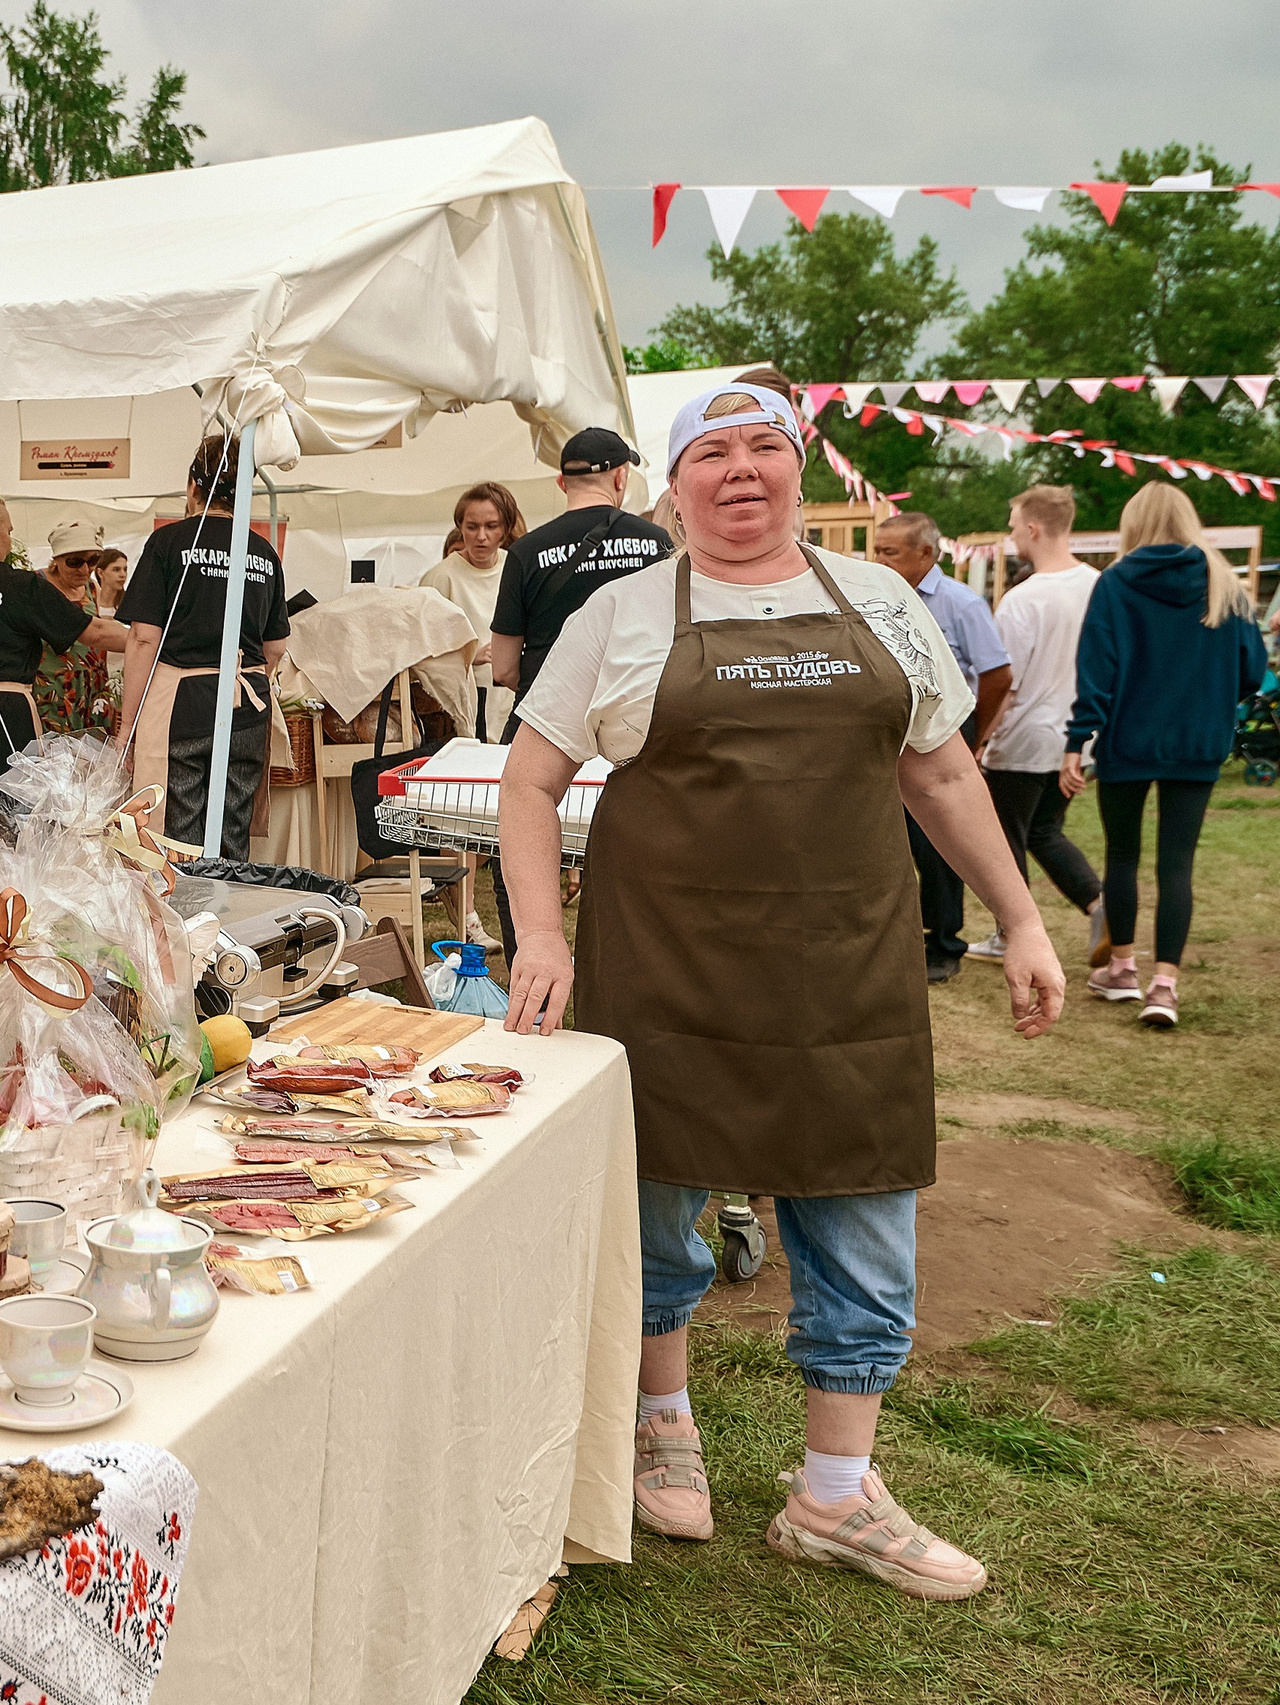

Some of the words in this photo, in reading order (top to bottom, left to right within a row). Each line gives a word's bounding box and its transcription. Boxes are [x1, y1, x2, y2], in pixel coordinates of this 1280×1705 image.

[31, 446, 59, 460] Роман
[601, 538, 659, 557] ХЛЕБОВ
[246, 554, 274, 577] ЛЕБОВ
[598, 557, 643, 570] ВКУСНЕЕ!
[200, 566, 206, 576] С
[796, 651, 814, 660] 2015
[716, 664, 772, 681] ПЯТЬ
[775, 660, 862, 680] ПУДОВЪ
[750, 680, 782, 689] МЯСНАЯ
[783, 677, 832, 688] МАСТЕРСКАЯ
